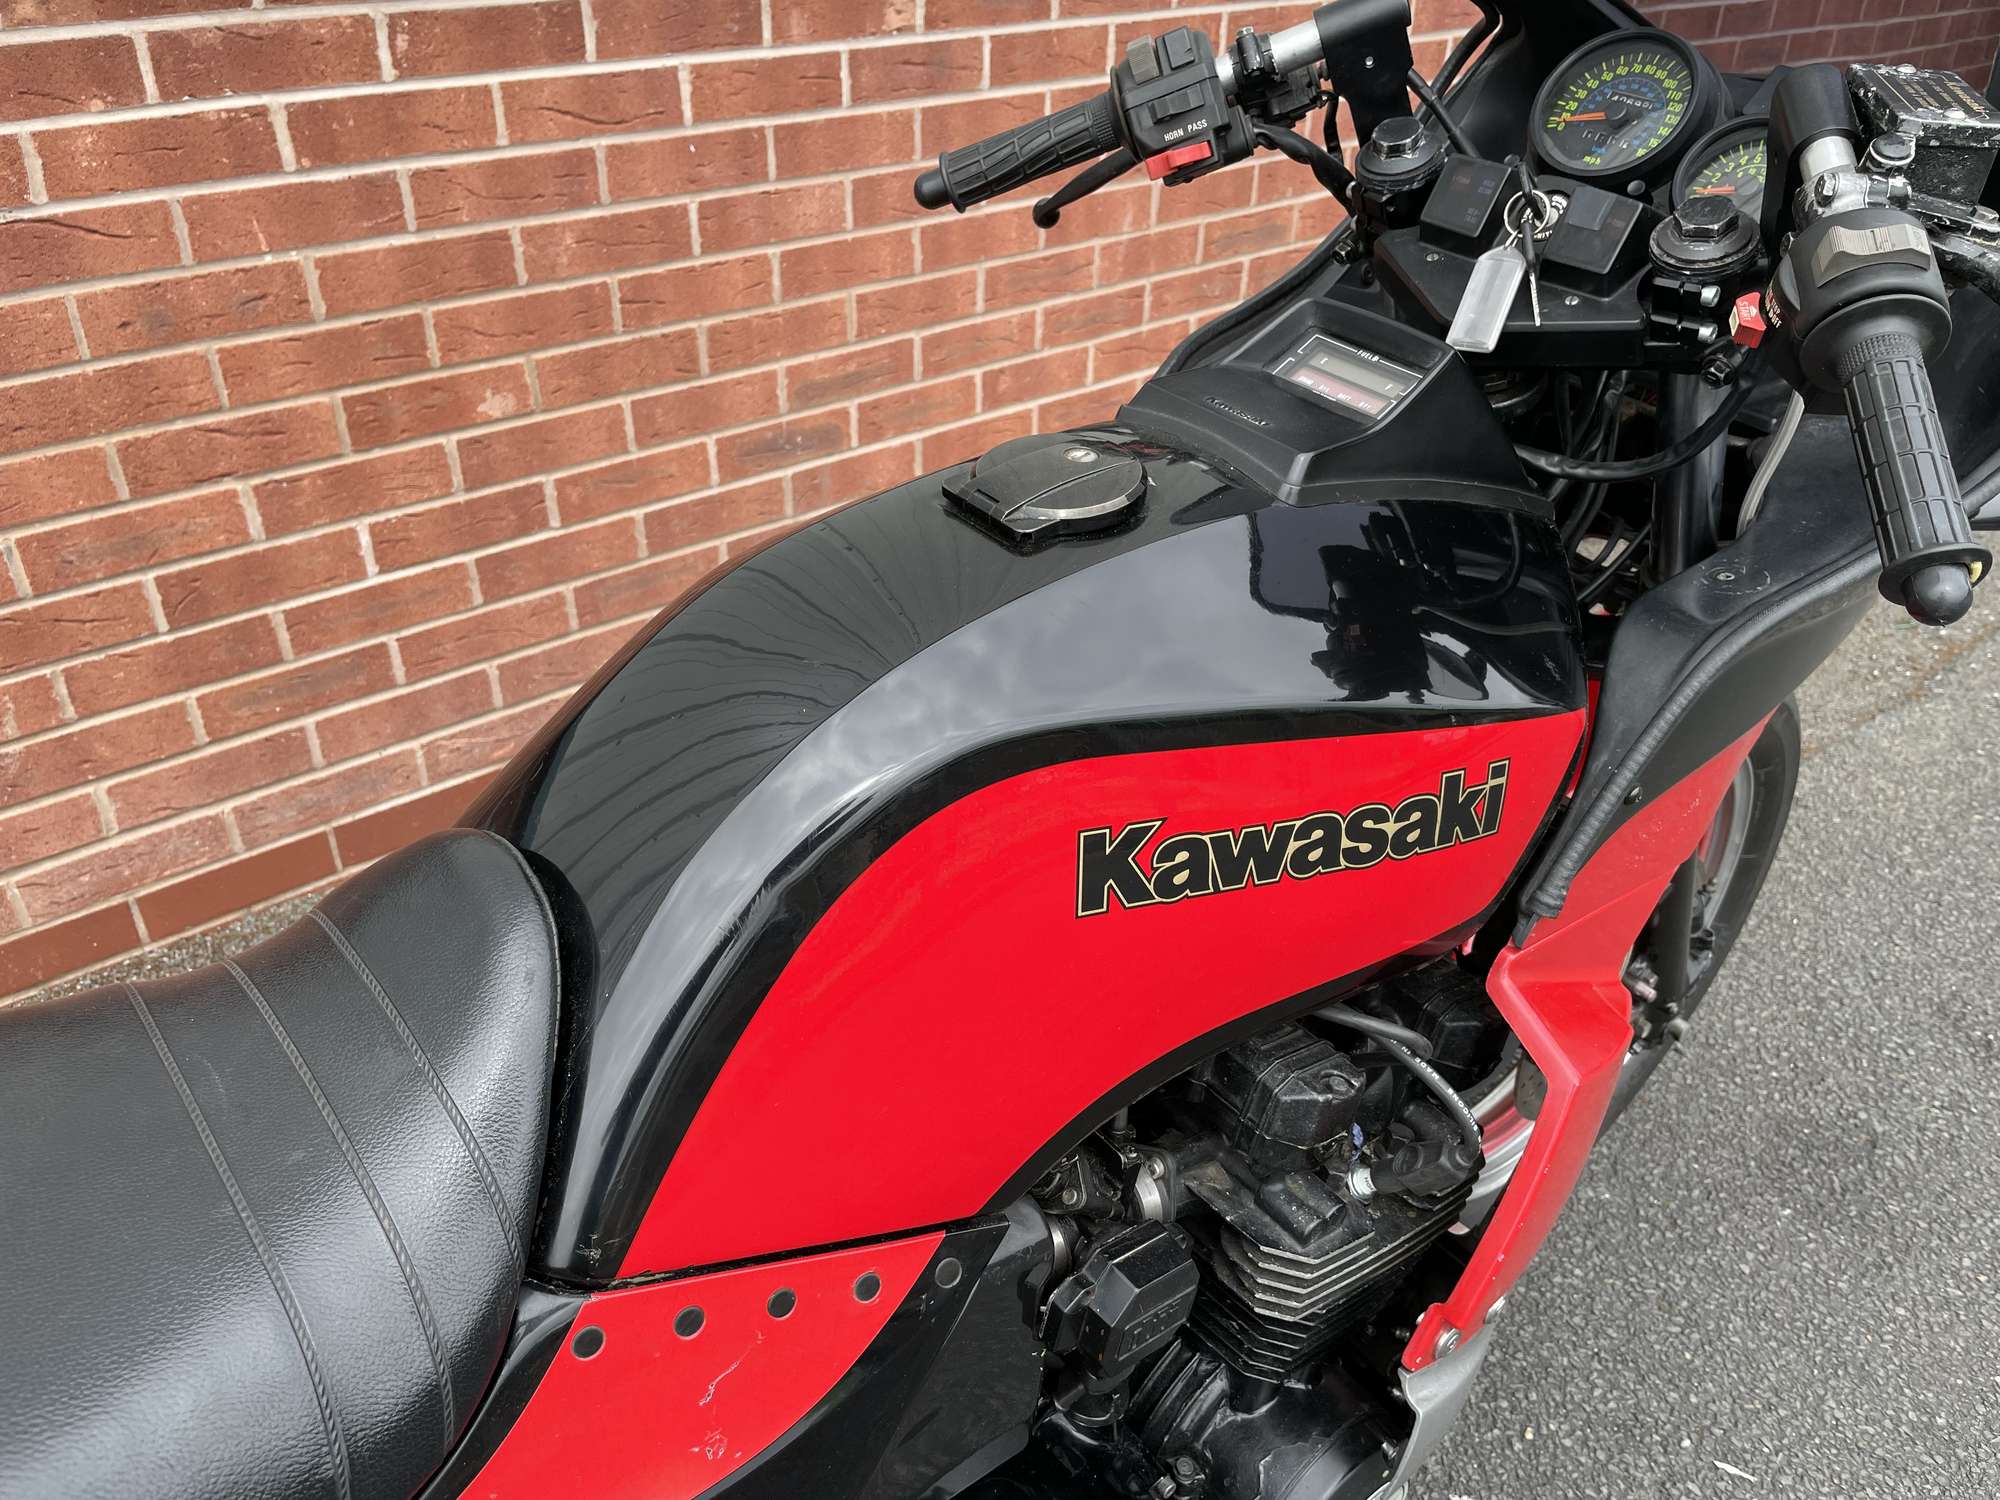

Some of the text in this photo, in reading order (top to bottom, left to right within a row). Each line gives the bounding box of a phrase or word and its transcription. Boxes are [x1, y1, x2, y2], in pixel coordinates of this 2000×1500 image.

[1615, 65, 1629, 76] 60
[1631, 63, 1643, 73] 70
[1643, 64, 1657, 75] 80
[1601, 71, 1614, 81] 50
[1654, 69, 1668, 80] 90
[1586, 79, 1600, 89] 40
[1662, 79, 1679, 90] 100
[1574, 89, 1588, 99] 30
[1666, 90, 1682, 101] 110
[1565, 100, 1579, 111] 20
[1667, 101, 1683, 112] 120
[1163, 119, 1208, 142] HORN PASS
[1556, 121, 1566, 131] 0
[1583, 155, 1600, 166] mph
[1739, 155, 1749, 165] 4
[1724, 162, 1735, 173] 3
[1711, 172, 1721, 183] 2
[1356, 349, 1373, 360] FUEL
[1074, 757, 1512, 919] Kawasaki
[1401, 1046, 1479, 1132] SILICONE MADE IN
